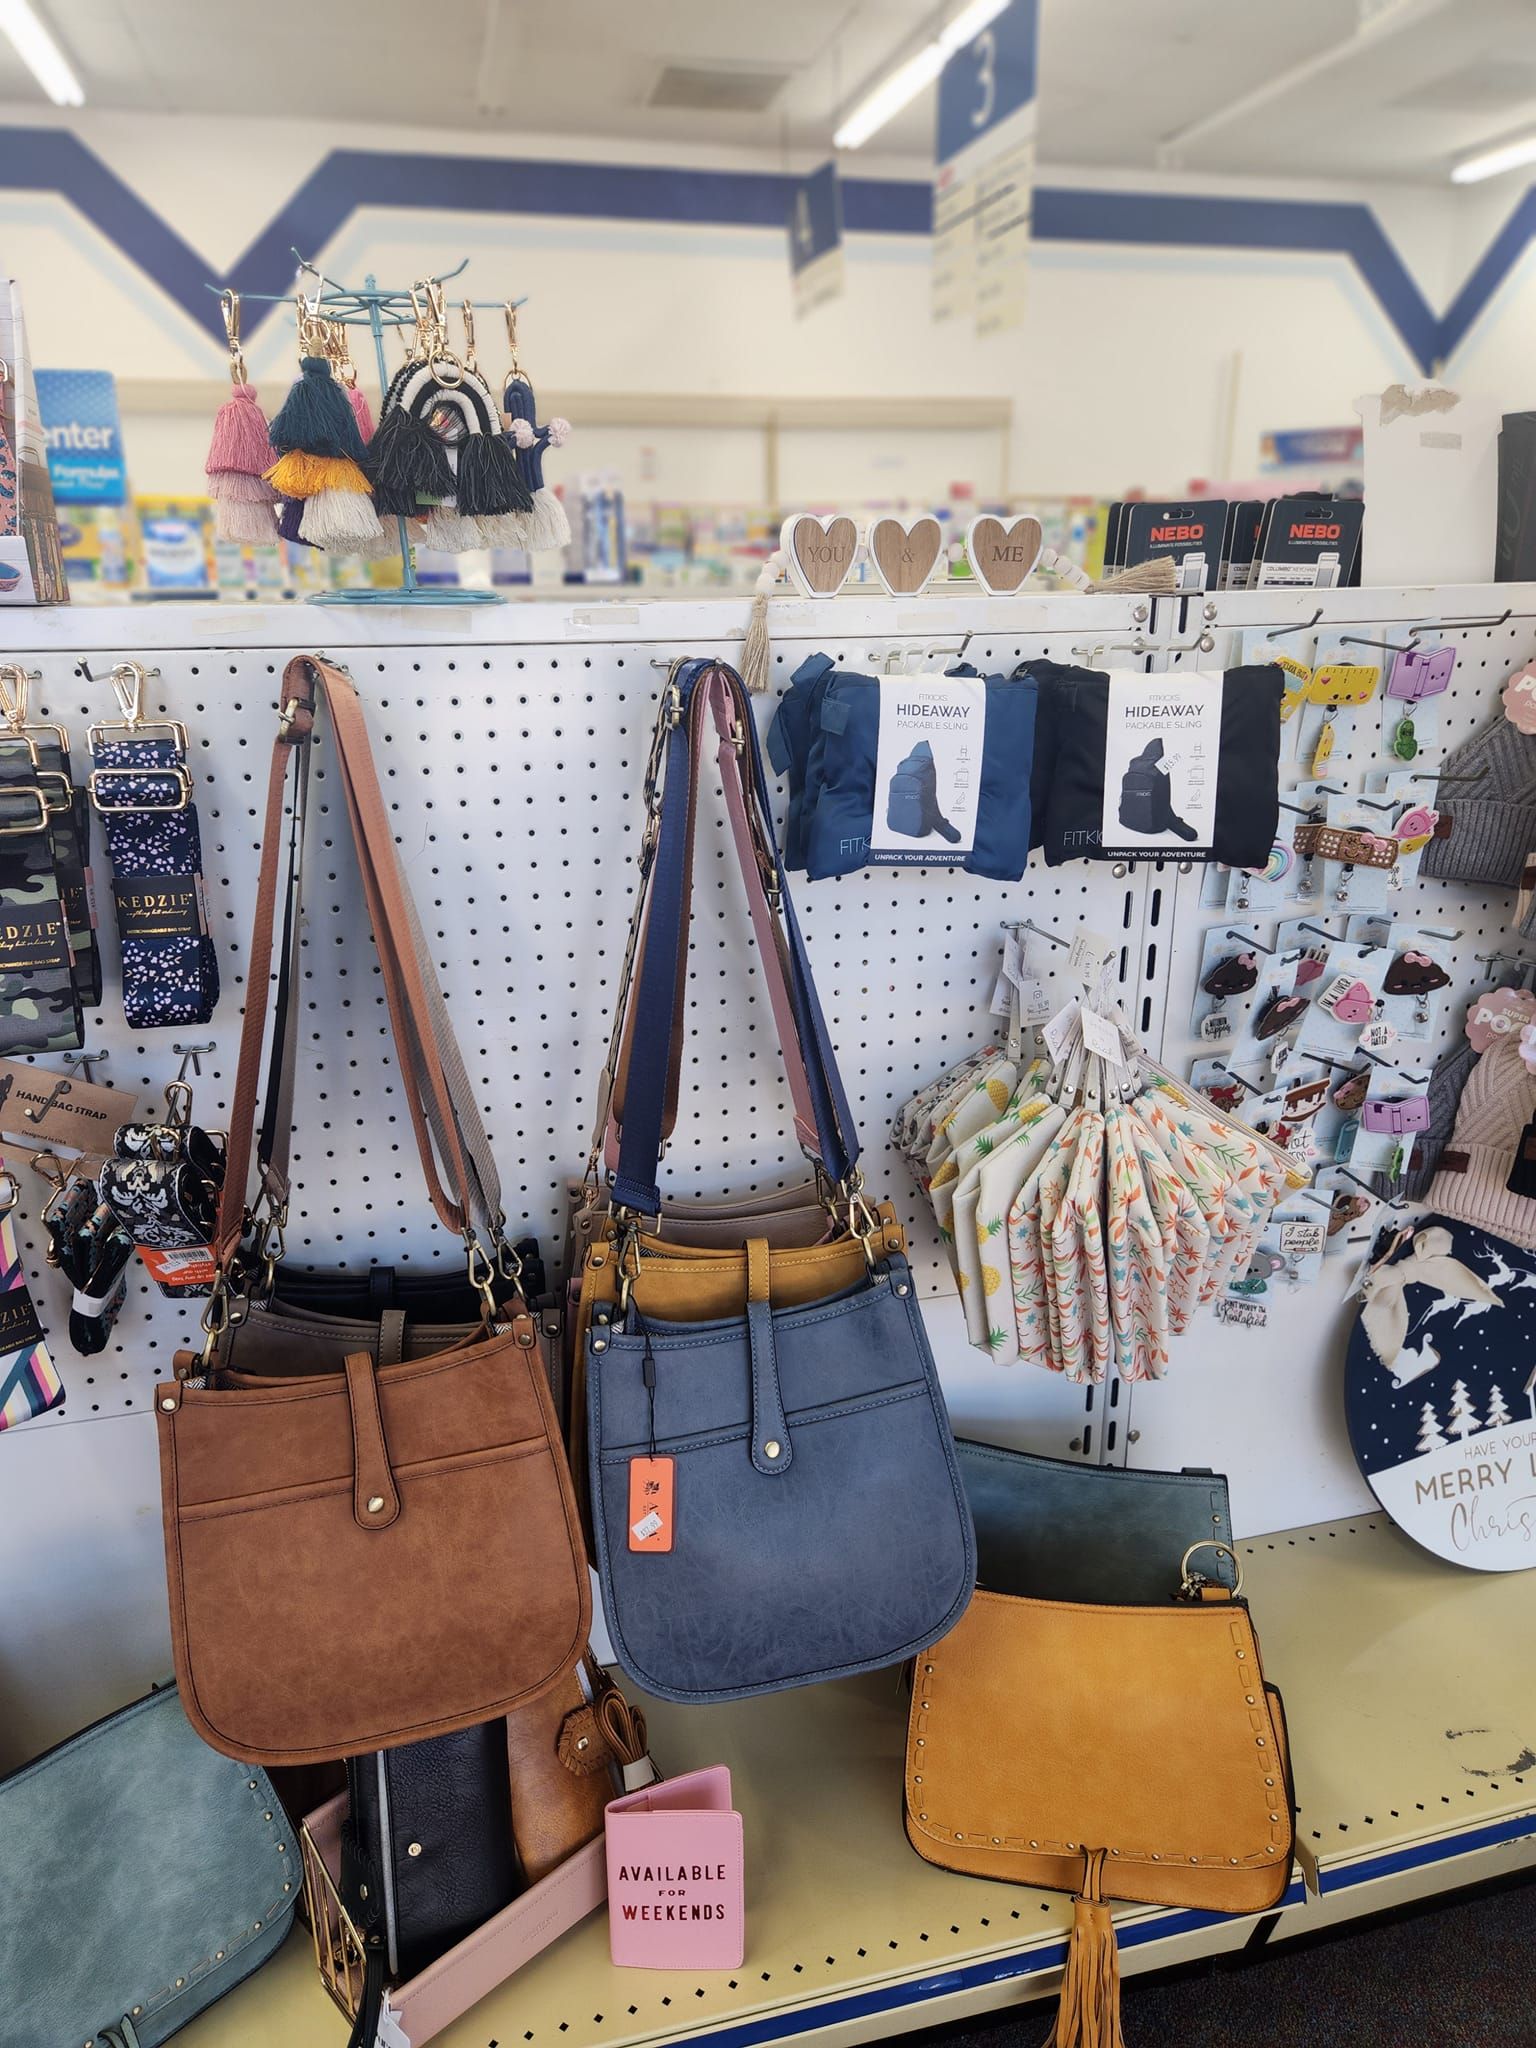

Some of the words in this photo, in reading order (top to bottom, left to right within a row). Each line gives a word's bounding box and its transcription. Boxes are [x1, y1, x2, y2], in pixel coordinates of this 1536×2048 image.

[970, 28, 996, 127] 3
[1150, 524, 1204, 541] NEBO
[1289, 524, 1341, 539] NEBO
[807, 546, 846, 563] YOU
[901, 549, 915, 564] &
[991, 546, 1025, 563] ME
[896, 703, 971, 718] HIDEAWAY
[1125, 704, 1205, 718] HIDEAWAY
[897, 720, 941, 730] PACKABLE
[942, 721, 969, 731] SLING
[1125, 721, 1172, 730] PACKABLE
[1174, 720, 1202, 729] SLING
[874, 853, 903, 861] UNPACK
[904, 854, 924, 862] YOUR
[1161, 851, 1207, 859] ADVENTURE
[117, 893, 190, 909] KEDZIE
[1502, 1007, 1530, 1024] SUPER
[1371, 1026, 1382, 1038] NOT
[16, 1089, 49, 1105] HAND
[50, 1099, 73, 1112] BAG
[75, 1105, 108, 1120] STRAP
[1297, 1227, 1320, 1238] stab
[1284, 1238, 1319, 1247] people
[1464, 1440, 1497, 1460] HAVE
[1415, 1457, 1513, 1505] MERRY
[619, 1864, 726, 1881] AVAILABLE
[658, 1889, 686, 1897] FOR
[622, 1903, 726, 1921] WEEKENDS
